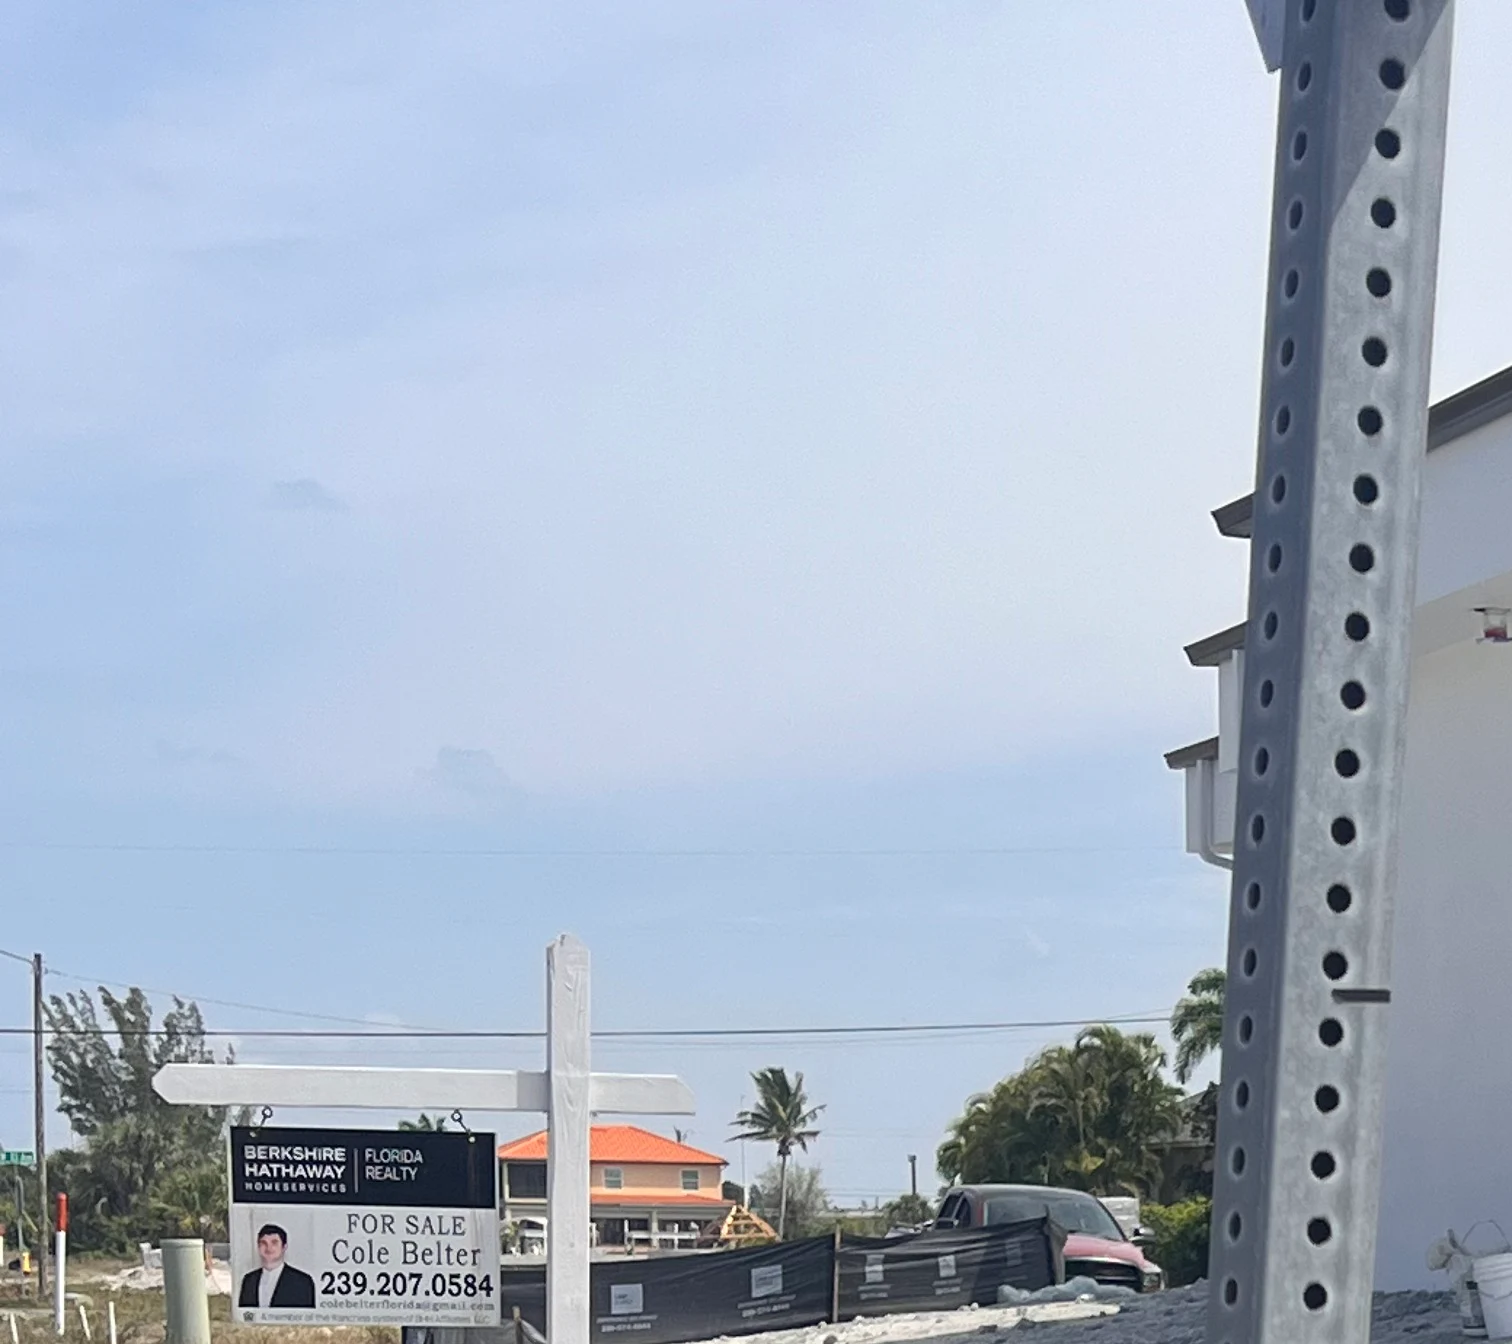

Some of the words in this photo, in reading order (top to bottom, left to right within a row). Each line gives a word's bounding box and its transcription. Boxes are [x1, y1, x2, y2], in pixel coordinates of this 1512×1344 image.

[244, 1145, 346, 1162] BERKSHIRE
[365, 1148, 423, 1163] FLORIDA
[245, 1163, 346, 1179] HATHAWAY
[366, 1166, 418, 1181] REALTY
[245, 1182, 346, 1193] HOMESERVICES
[347, 1213, 396, 1235] FOR
[405, 1214, 467, 1236] SALE
[332, 1239, 389, 1265] Cole
[401, 1240, 480, 1266] Belter
[320, 1271, 493, 1297] 239.207.0584
